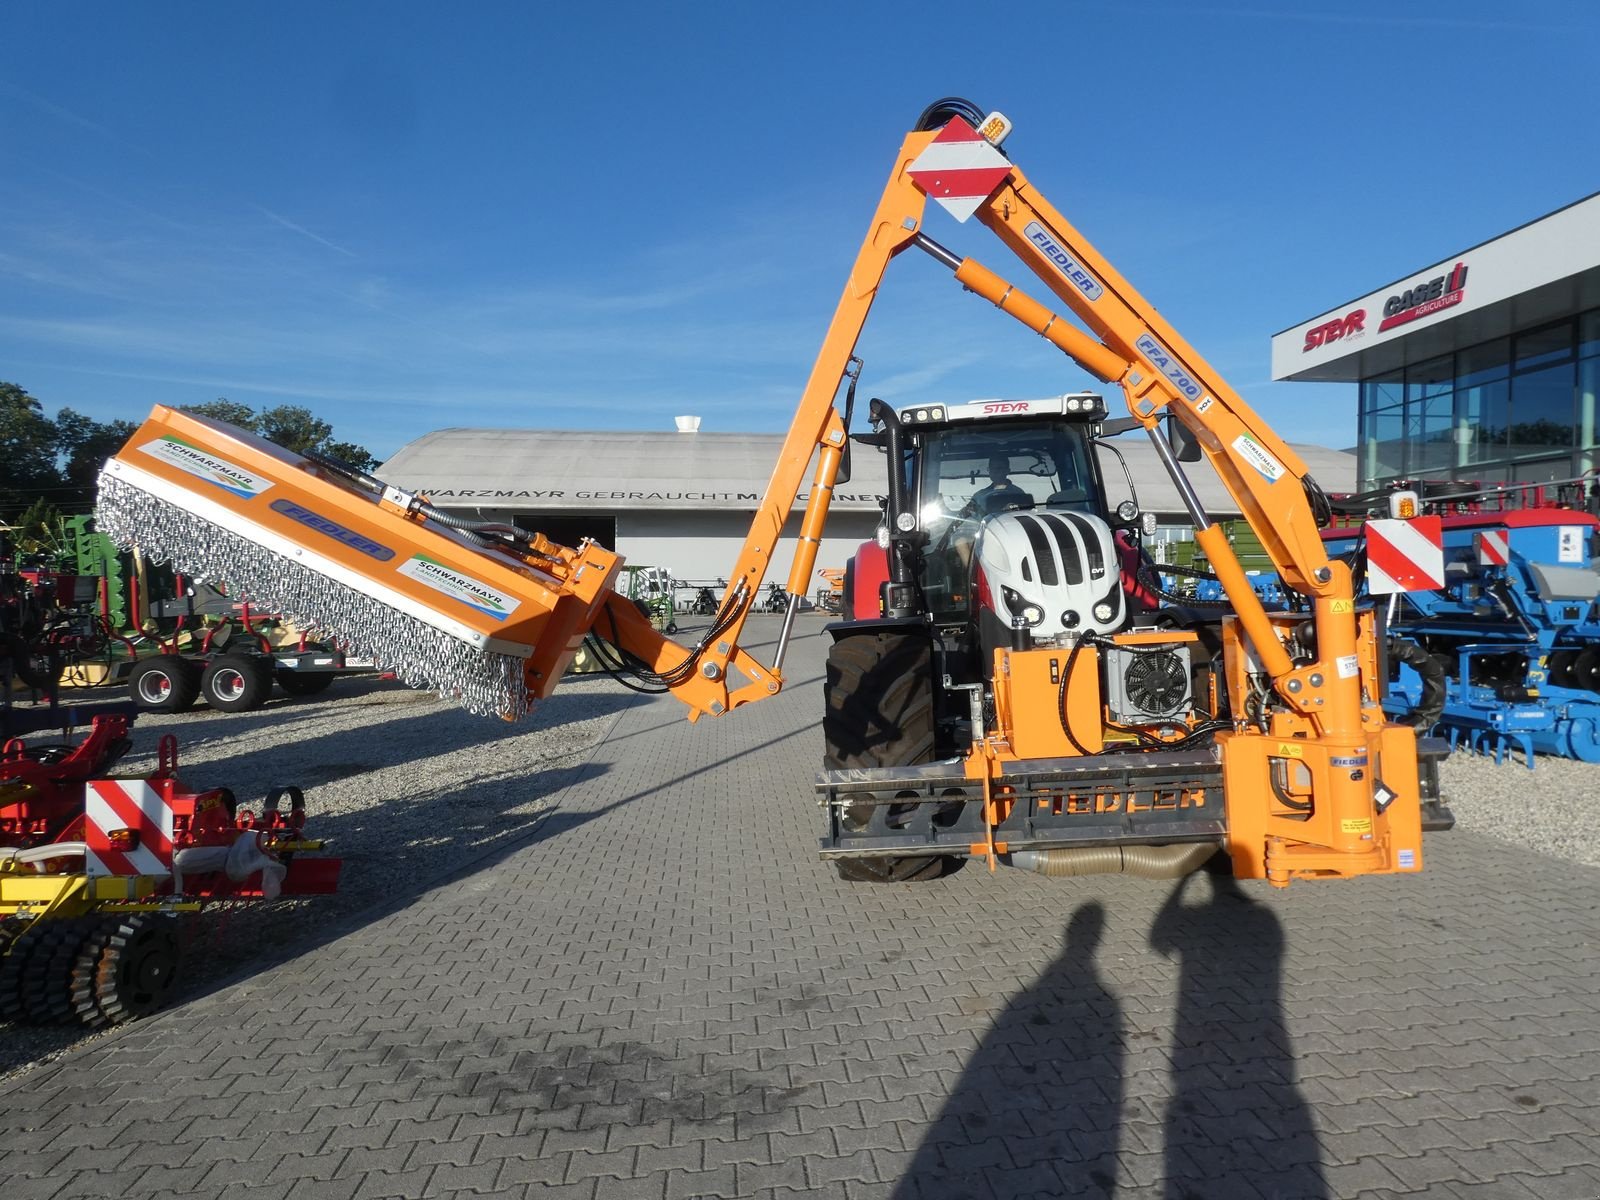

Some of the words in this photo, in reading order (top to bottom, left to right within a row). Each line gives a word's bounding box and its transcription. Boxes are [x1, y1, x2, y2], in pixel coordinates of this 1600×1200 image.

[1032, 232, 1094, 292] FIEDLER
[1383, 276, 1445, 318] CASE
[1415, 293, 1459, 317] AGRICULTURE
[1302, 309, 1366, 353] STEYR
[1140, 341, 1169, 368] FFA
[1169, 369, 1198, 395] 700
[984, 402, 1029, 414] STEYR
[165, 442, 253, 484] SCHWARZMAYR
[1243, 438, 1276, 471] SCHWARZMAYR
[411, 489, 565, 498] WARZMAYR
[284, 507, 382, 554] FIEDLER
[418, 561, 502, 604] SCHWARZMAYR
